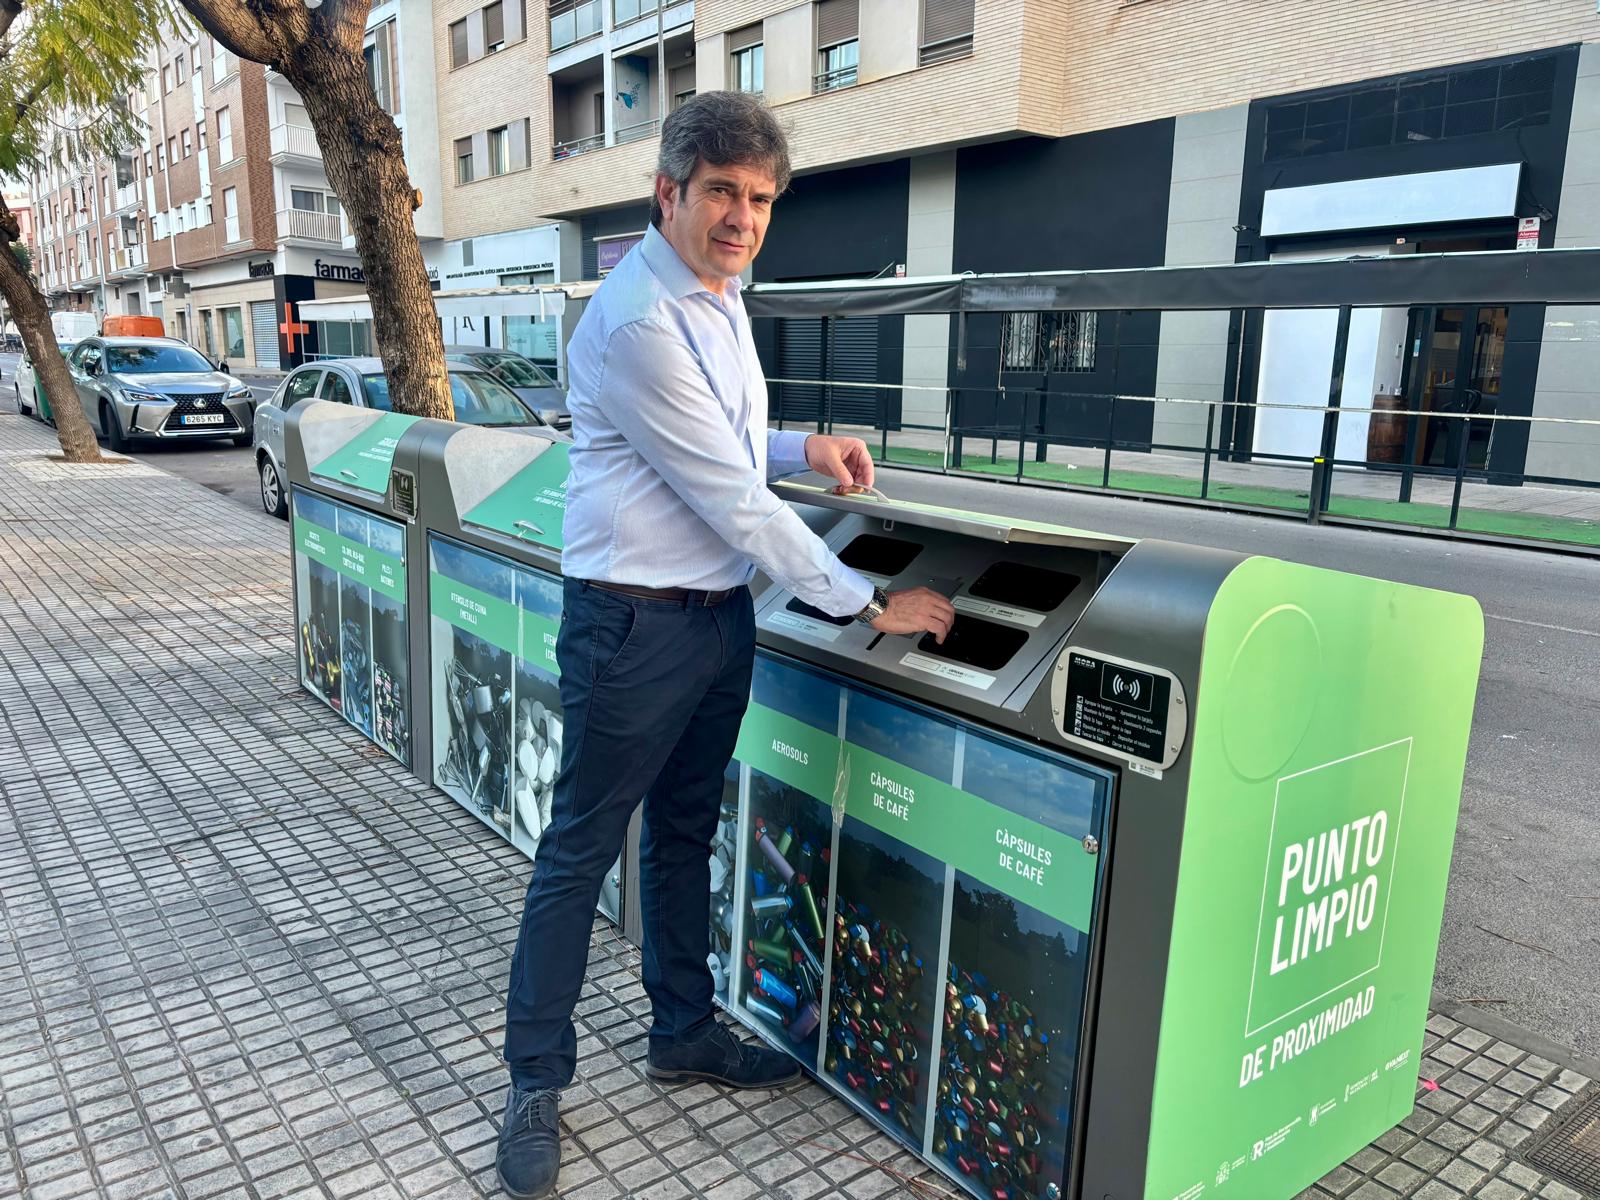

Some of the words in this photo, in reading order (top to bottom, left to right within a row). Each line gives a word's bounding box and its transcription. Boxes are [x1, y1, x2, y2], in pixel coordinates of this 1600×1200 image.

[771, 737, 809, 766] AEROSOLS
[869, 770, 915, 804] CÀPSULES
[872, 792, 885, 809] DE
[886, 795, 910, 822] CAFÉ
[995, 827, 1052, 866] CÀPSULES
[1278, 810, 1388, 907] PUNTO
[999, 854, 1014, 872] DE
[1015, 859, 1045, 887] CAFÉ
[1269, 874, 1378, 976] LIMPIO
[1239, 1045, 1266, 1089] DE
[1269, 985, 1376, 1071] PROXIMIDAD
